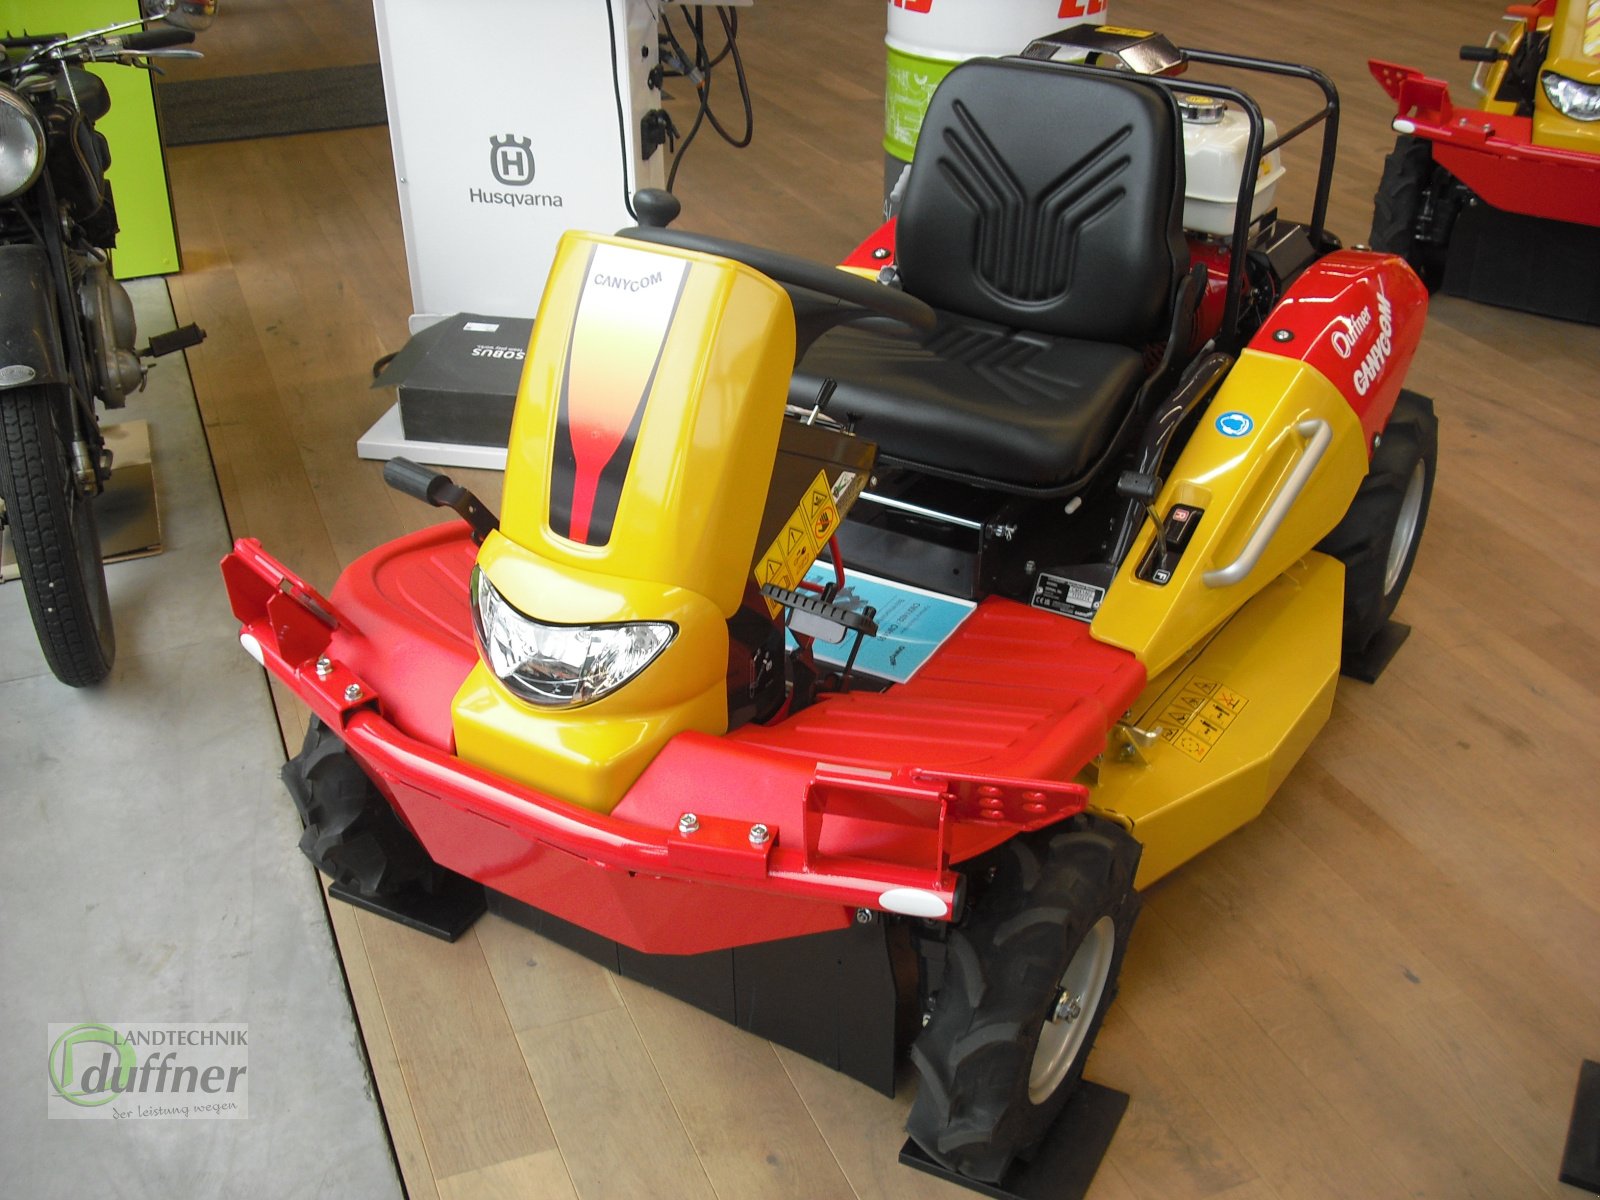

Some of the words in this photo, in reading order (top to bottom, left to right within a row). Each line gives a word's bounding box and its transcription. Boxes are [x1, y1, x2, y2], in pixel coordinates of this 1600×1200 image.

[469, 187, 563, 207] Husqvarna
[594, 271, 662, 292] CANYCOM
[1331, 305, 1372, 359] Duffner
[1353, 275, 1392, 396] CANYCOM
[471, 348, 526, 360] SOBUS
